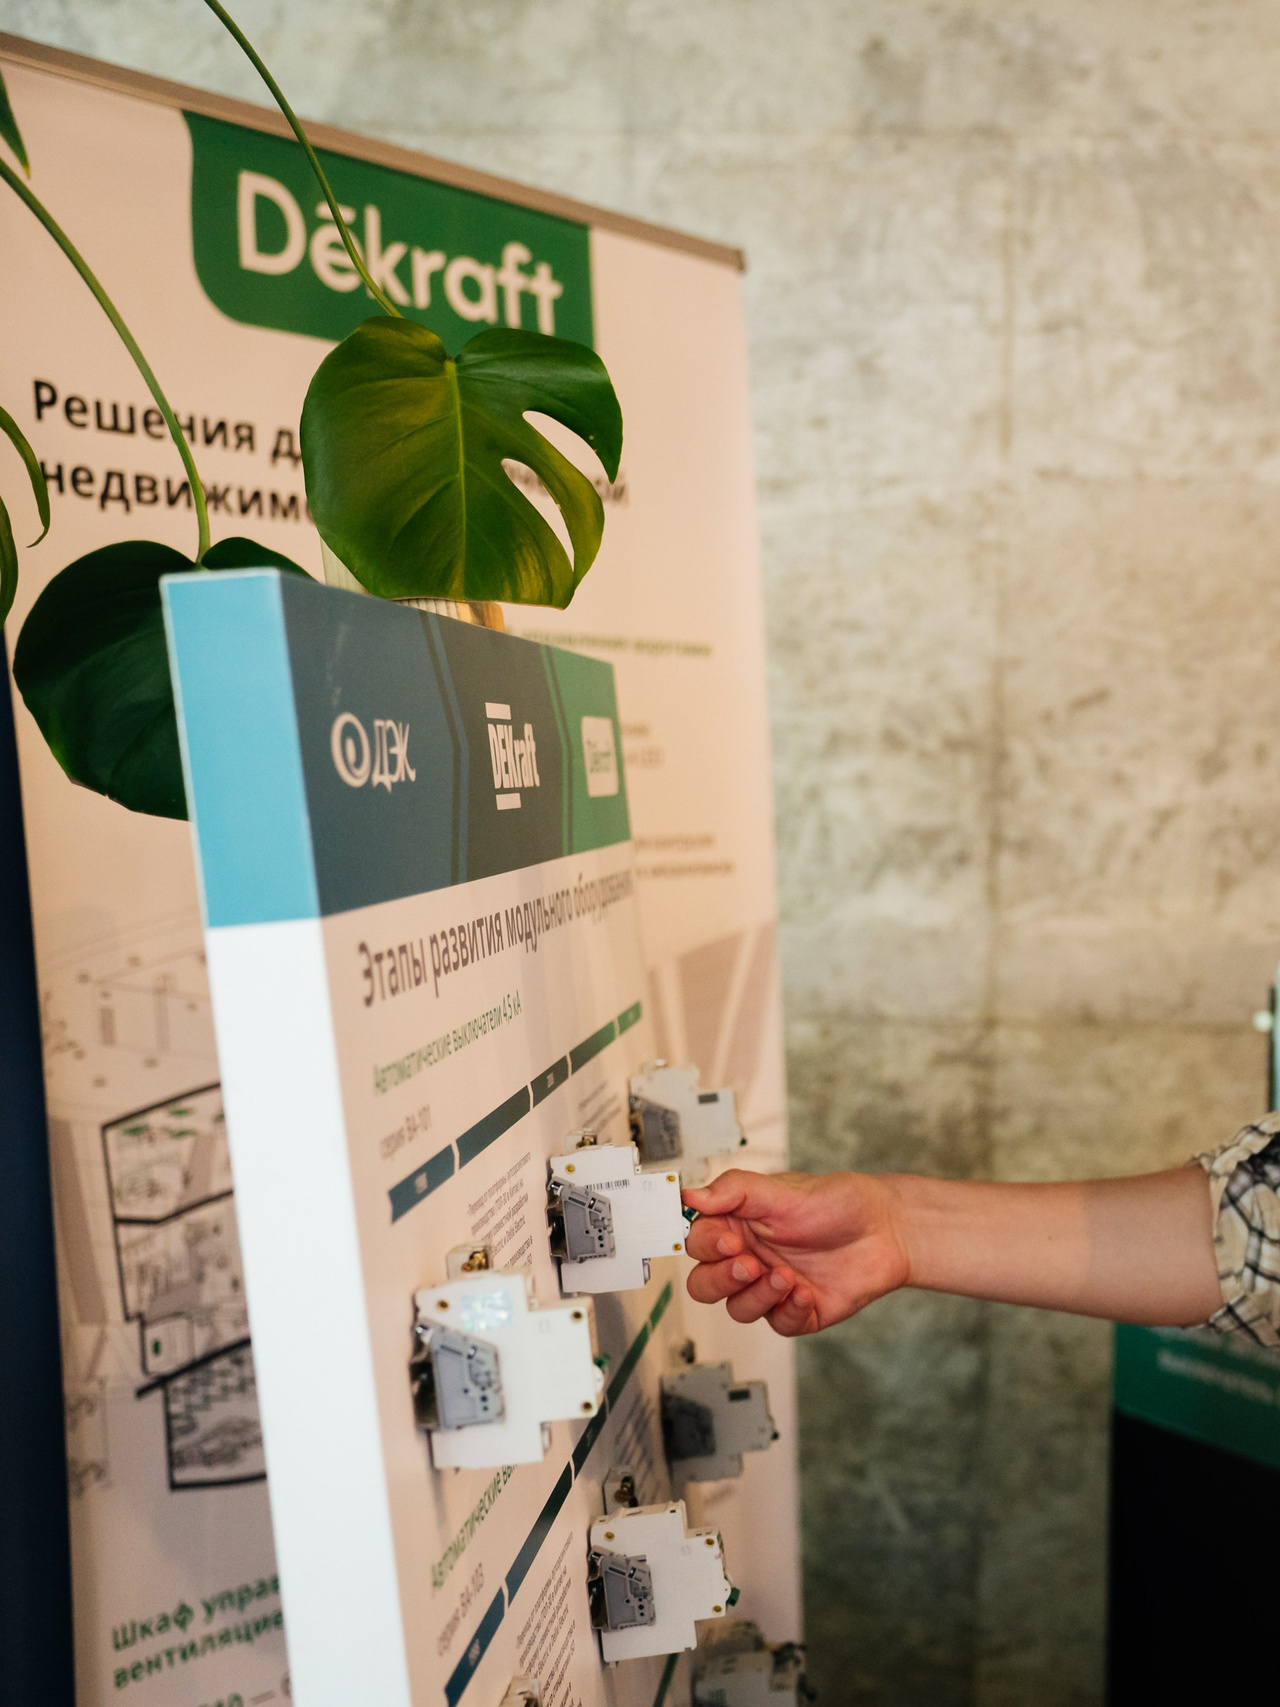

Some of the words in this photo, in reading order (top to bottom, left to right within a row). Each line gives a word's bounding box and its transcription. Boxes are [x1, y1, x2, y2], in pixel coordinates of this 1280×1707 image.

[33, 379, 256, 453] Решения
[487, 722, 540, 789] DEKraft
[358, 938, 428, 1008] Этапы
[429, 911, 504, 999] развития
[504, 886, 574, 954] модульного
[452, 1006, 503, 1052] выключатели
[112, 1600, 194, 1653] Шкаф
